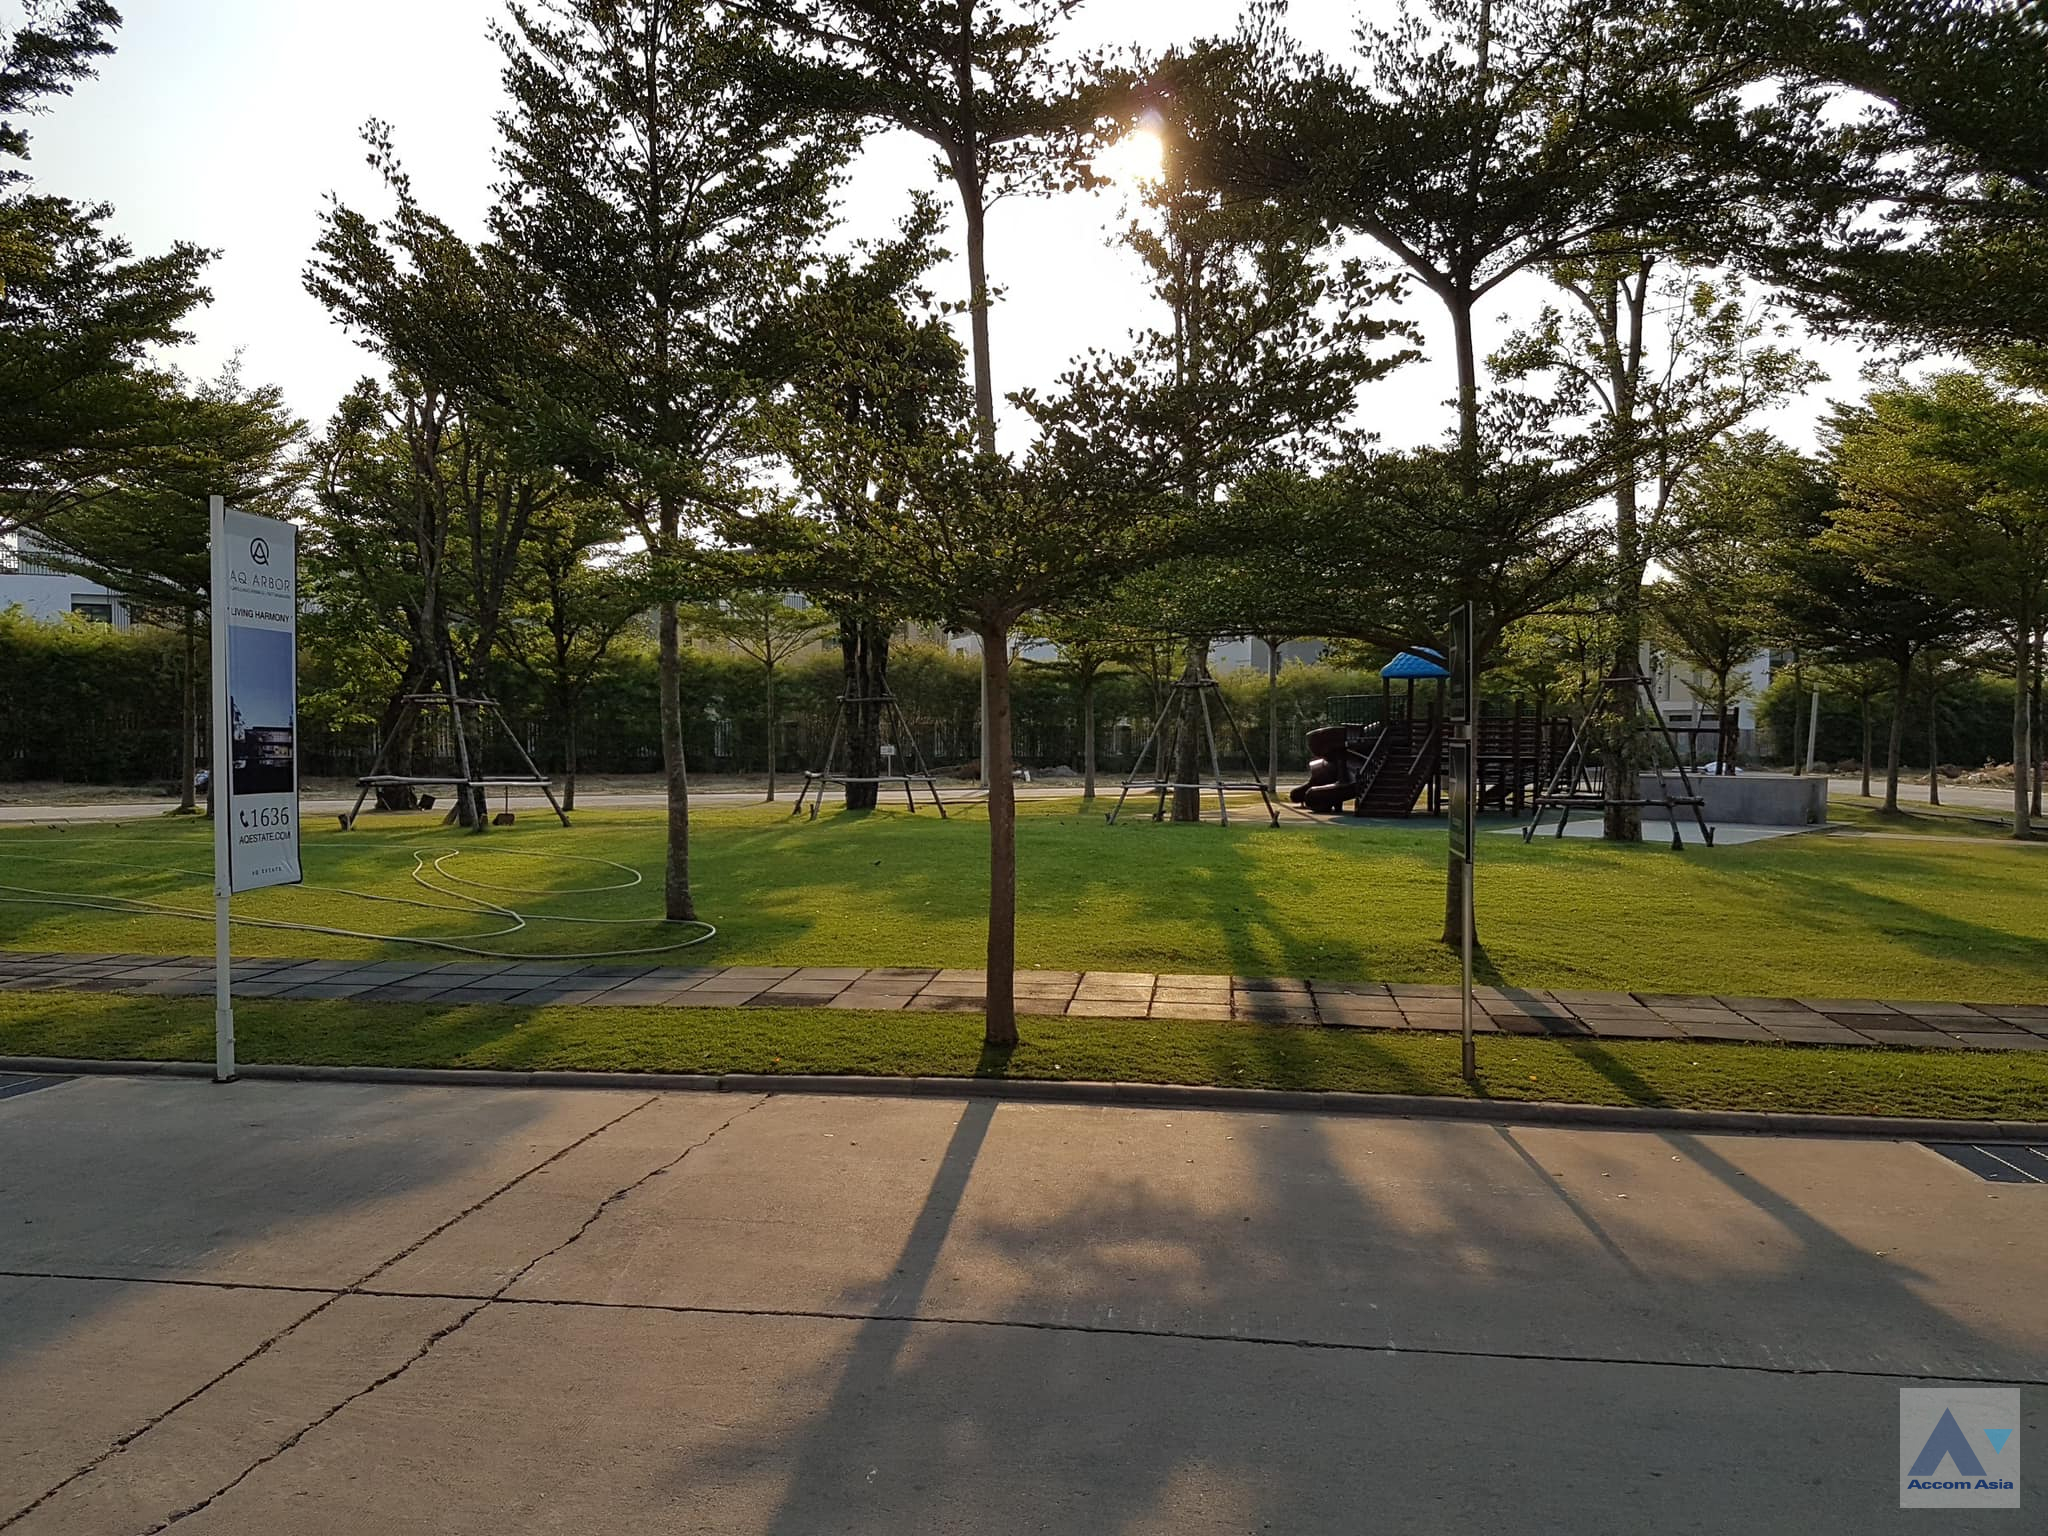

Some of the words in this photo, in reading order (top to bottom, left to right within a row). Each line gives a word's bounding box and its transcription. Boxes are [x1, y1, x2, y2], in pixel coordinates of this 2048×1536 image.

[230, 570, 247, 585] AQ
[252, 574, 290, 592] ARBOR
[251, 807, 289, 828] 1636
